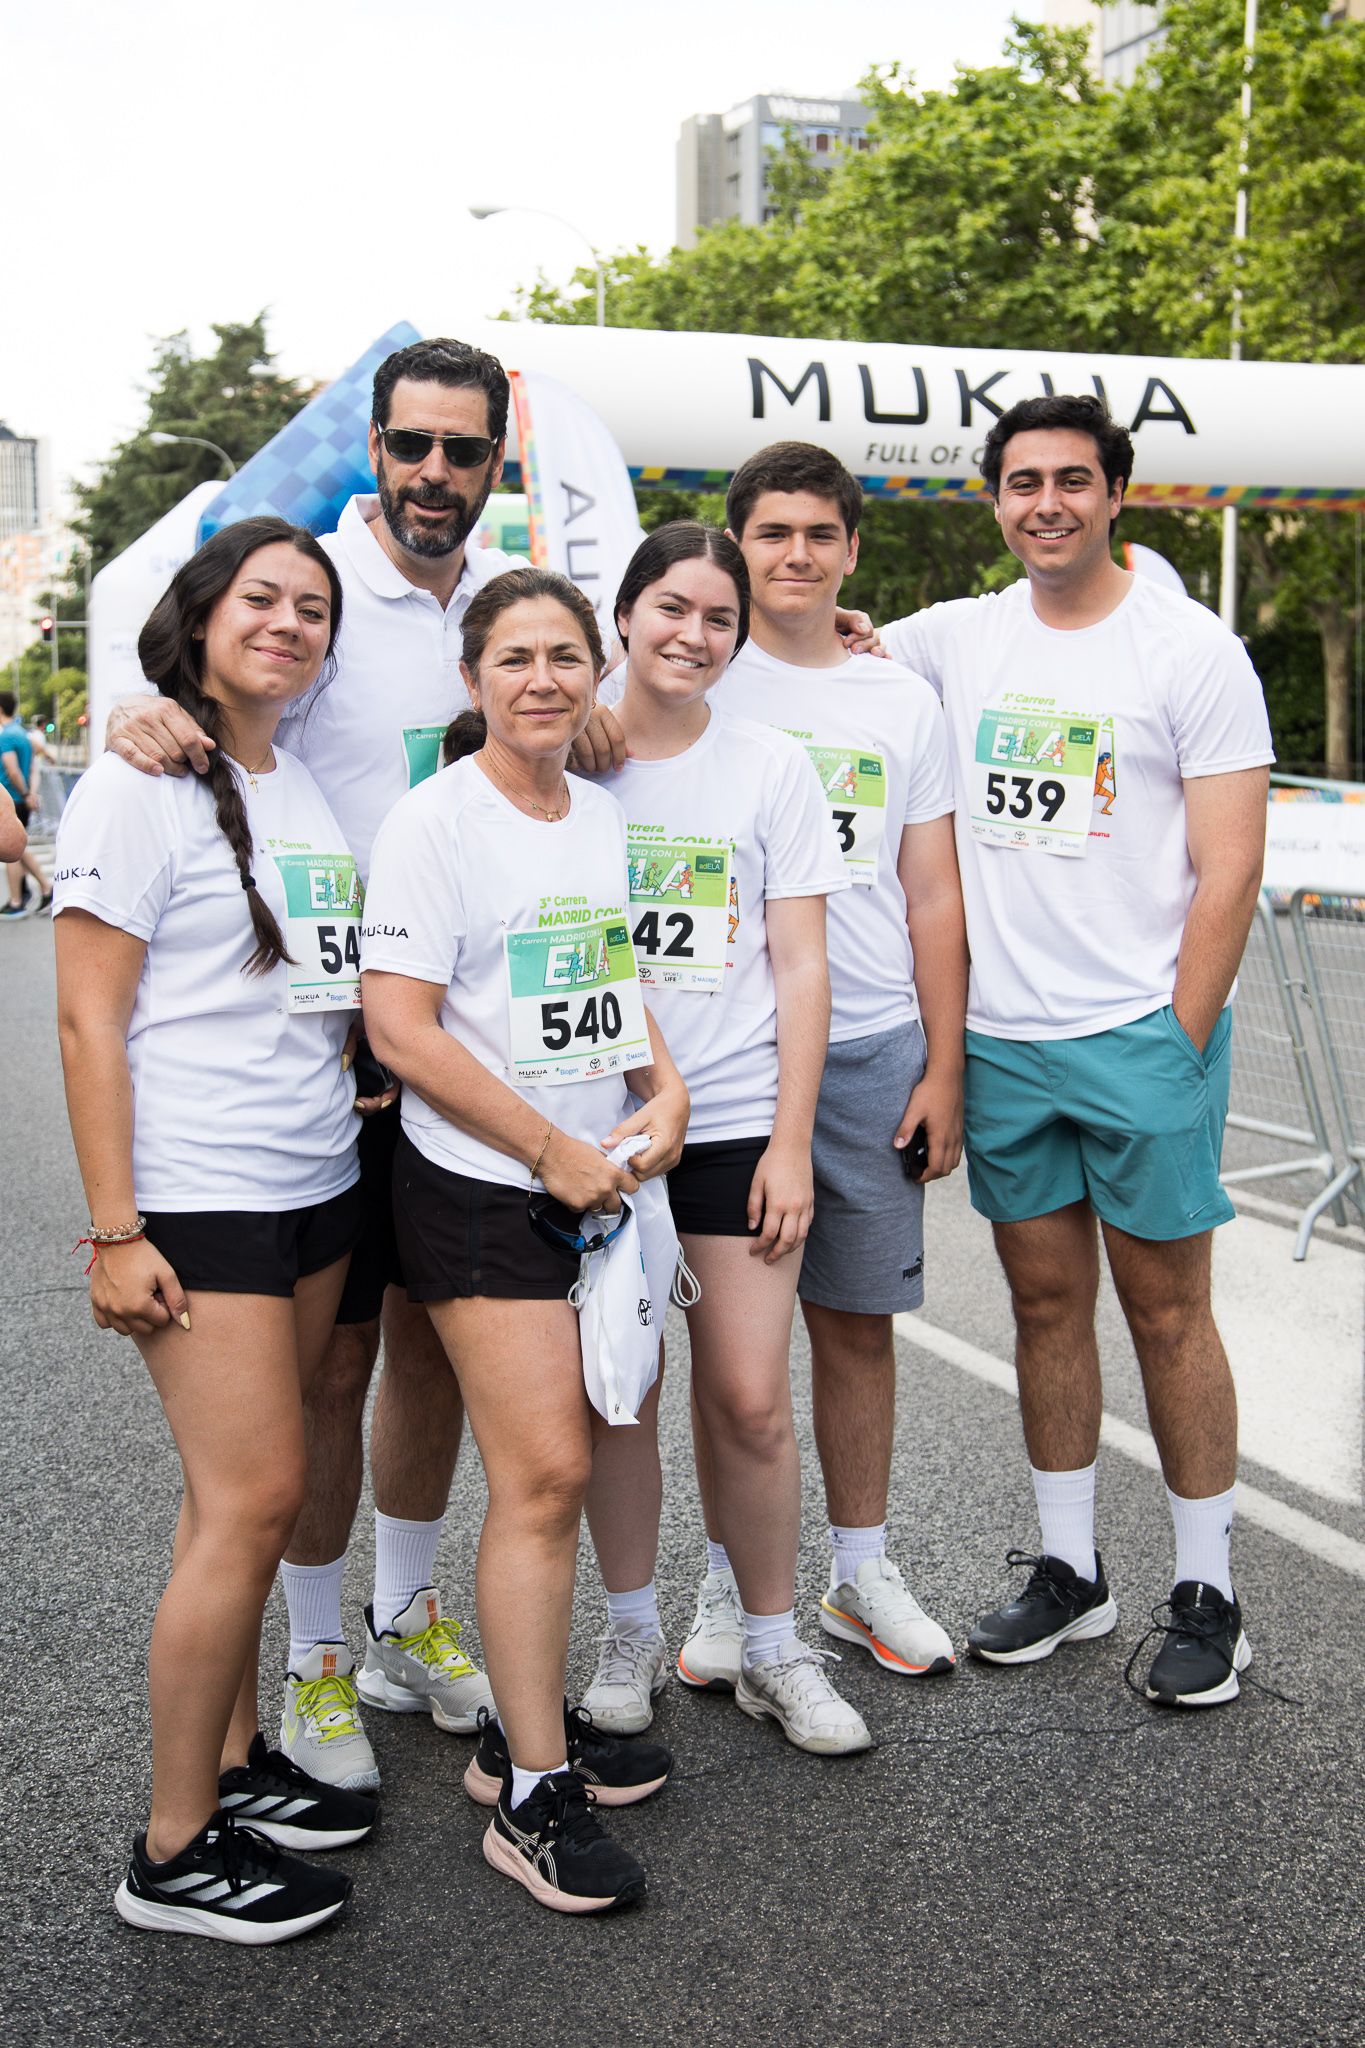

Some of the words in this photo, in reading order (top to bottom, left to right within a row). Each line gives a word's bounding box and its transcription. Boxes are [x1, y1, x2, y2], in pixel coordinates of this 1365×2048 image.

[866, 443, 919, 463] FULL
[930, 445, 962, 465] OF
[1015, 693, 1056, 706] Carrera
[817, 751, 838, 759] CON
[991, 725, 1064, 768] ELA
[986, 772, 1066, 823] 539
[627, 848, 648, 857] DRID
[650, 849, 672, 858] CON
[554, 896, 588, 906] Carrera
[538, 909, 591, 928] MADRID
[550, 932, 586, 944] MADRID
[632, 911, 695, 958] 42
[317, 926, 361, 975] 54
[543, 937, 611, 988] ELA
[541, 991, 623, 1051] 540
